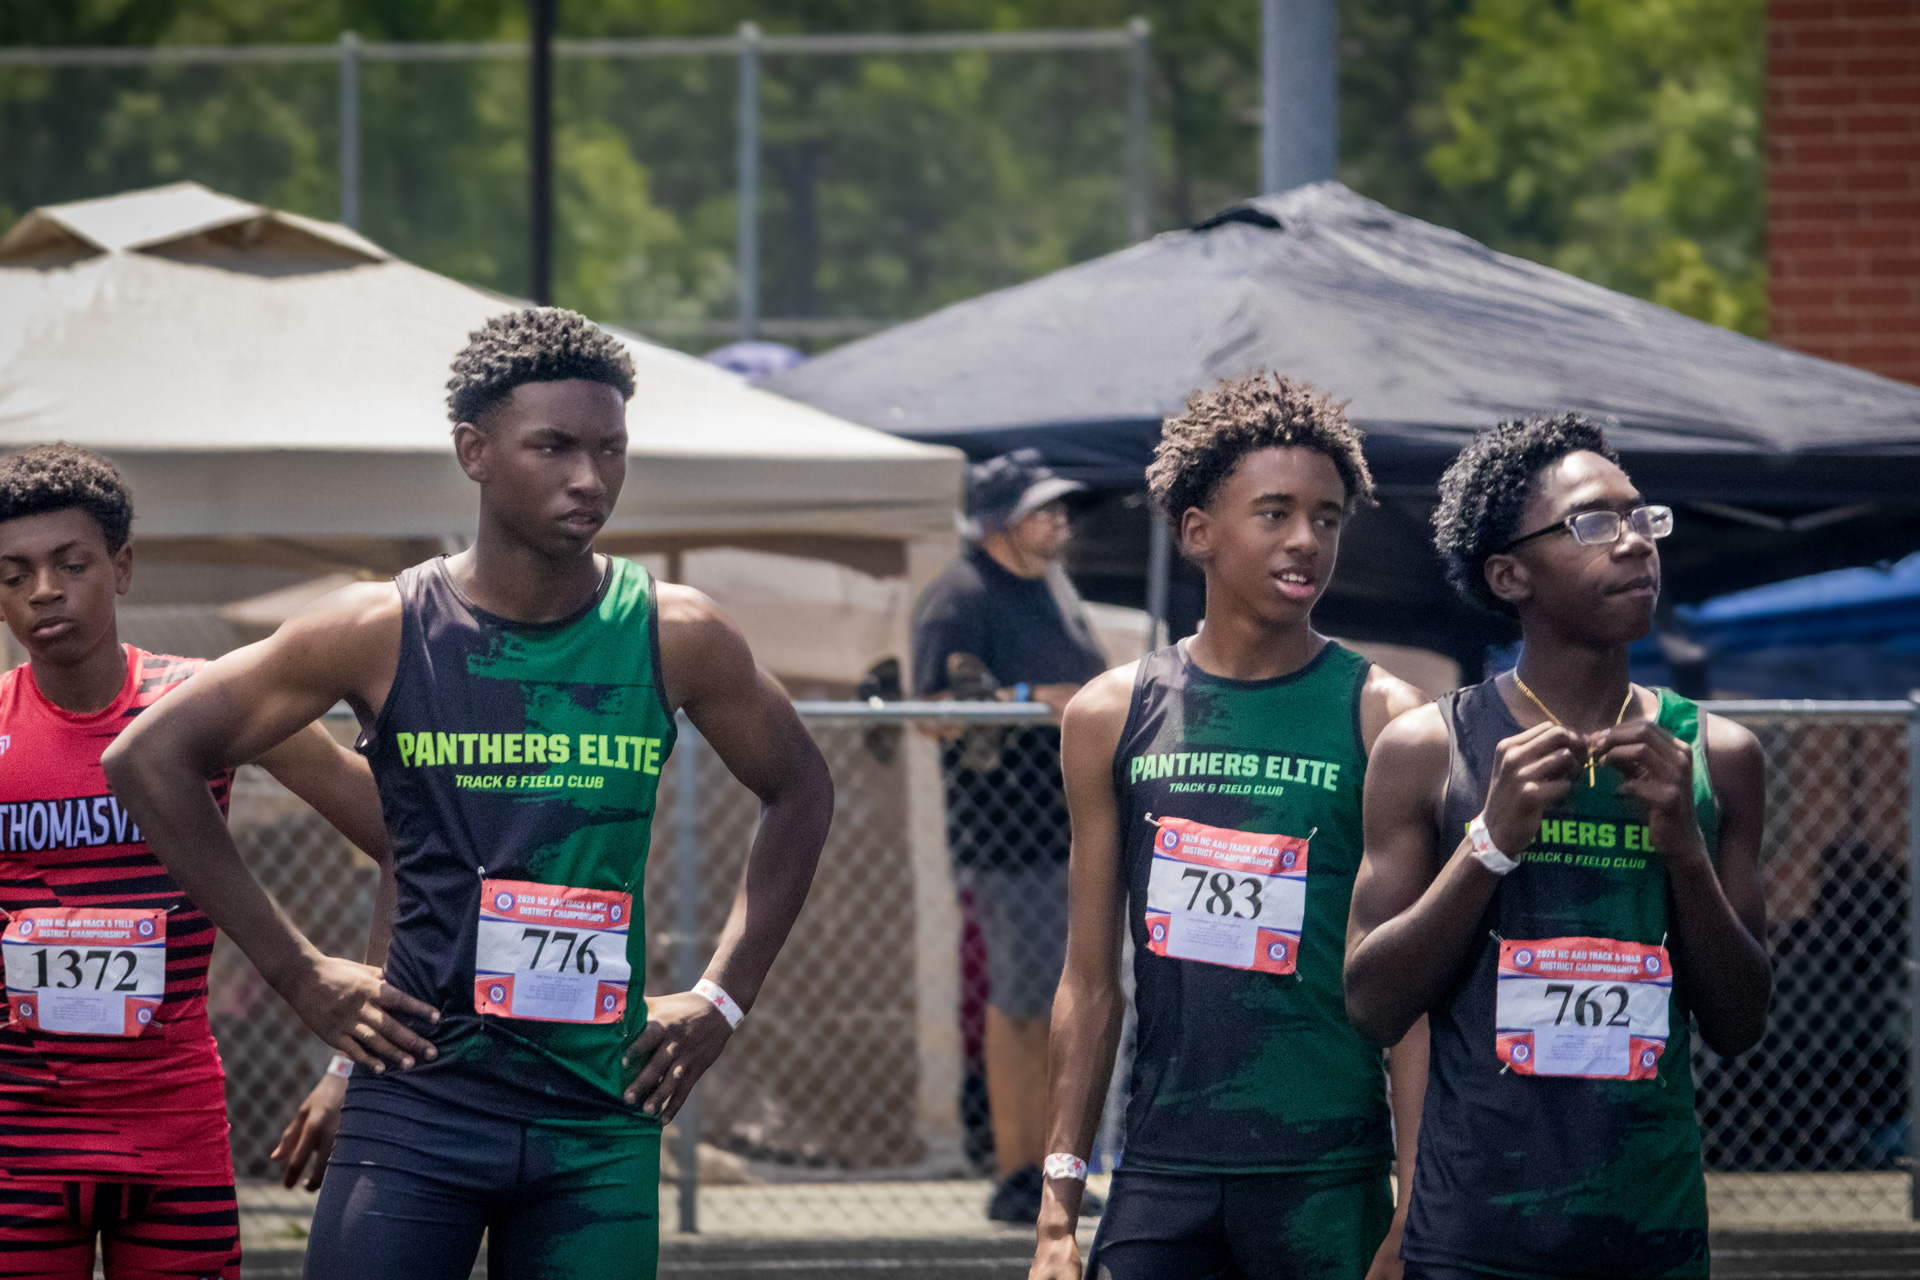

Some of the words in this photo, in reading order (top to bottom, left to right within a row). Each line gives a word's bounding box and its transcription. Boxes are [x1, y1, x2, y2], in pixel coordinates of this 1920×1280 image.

[397, 732, 570, 767] PANTHERS
[579, 734, 661, 775] ELITE
[1130, 752, 1260, 785] PANTHERS
[1265, 756, 1341, 791] ELITE
[455, 774, 503, 789] TRACK
[506, 775, 517, 788] &
[520, 775, 564, 789] FIELD
[567, 775, 605, 789] CLUB
[1169, 782, 1205, 793] TRACK
[1207, 783, 1216, 793] &
[1218, 783, 1252, 795] FIELD
[1253, 785, 1284, 796] CLUB
[0, 796, 145, 851] THOMASV
[1182, 845, 1213, 857] DISTRICT
[1214, 851, 1274, 867] CHAMPIONSHIPS
[1200, 836, 1212, 846] NC
[1212, 839, 1228, 850] AAU
[1229, 842, 1251, 853] TRACK
[1259, 846, 1280, 857] FIELD
[1521, 851, 1562, 864] TRACK
[1564, 854, 1573, 864] &
[1575, 855, 1611, 868] FIELD
[1613, 857, 1647, 869] CLUB
[537, 896, 548, 906] NC
[1181, 867, 1263, 920] 783
[54, 919, 65, 927] NC
[83, 919, 105, 928] TRACK
[114, 919, 134, 928] FIELD
[519, 906, 552, 917] DISTRICT
[554, 909, 605, 922] CHAMPIONSHIPS
[38, 929, 69, 938] DISTRICT
[71, 930, 131, 939] CHAMPIONSHIPS
[521, 928, 600, 974] 776
[1558, 950, 1570, 959] NC
[1571, 950, 1587, 960] AAU
[1589, 951, 1613, 961] TRACK
[1622, 954, 1641, 963] FIELD
[30, 949, 139, 992] 1372
[1540, 961, 1574, 971] DISTRICT
[1575, 963, 1639, 975] CHAMPIONSHIPS
[1544, 983, 1631, 1027] 762
